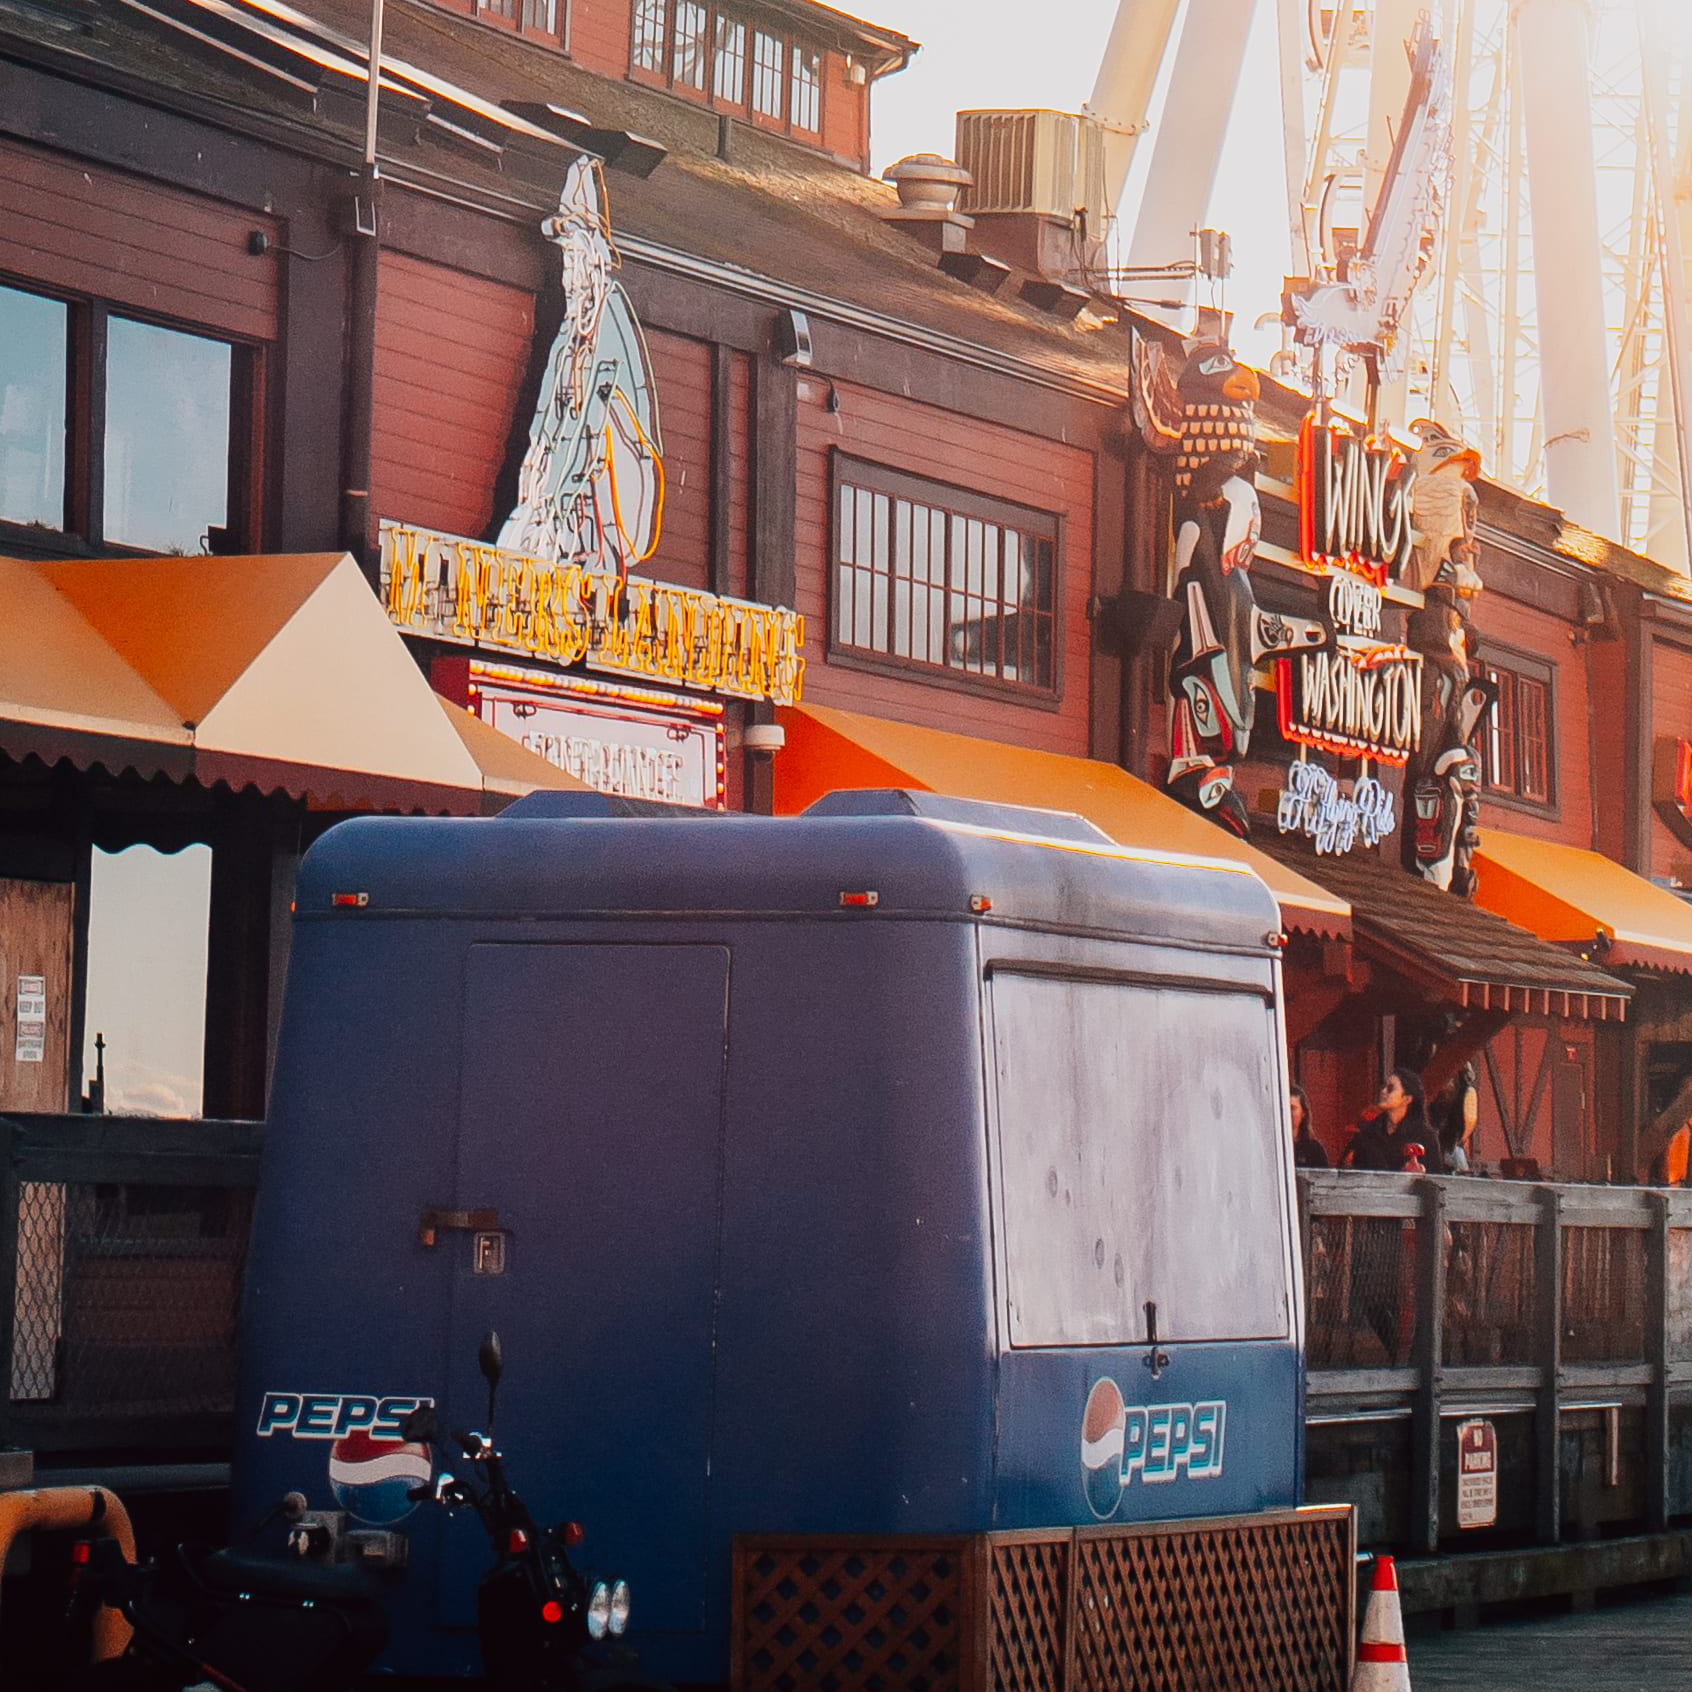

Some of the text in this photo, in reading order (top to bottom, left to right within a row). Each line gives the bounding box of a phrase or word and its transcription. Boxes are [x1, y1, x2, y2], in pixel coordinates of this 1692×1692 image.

[1324, 424, 1416, 573] WINGS
[590, 571, 805, 704] LANDING
[1301, 650, 1422, 752] WASHINGTON
[256, 1391, 435, 1440] PEPS
[1119, 1399, 1226, 1487] PEPSI
